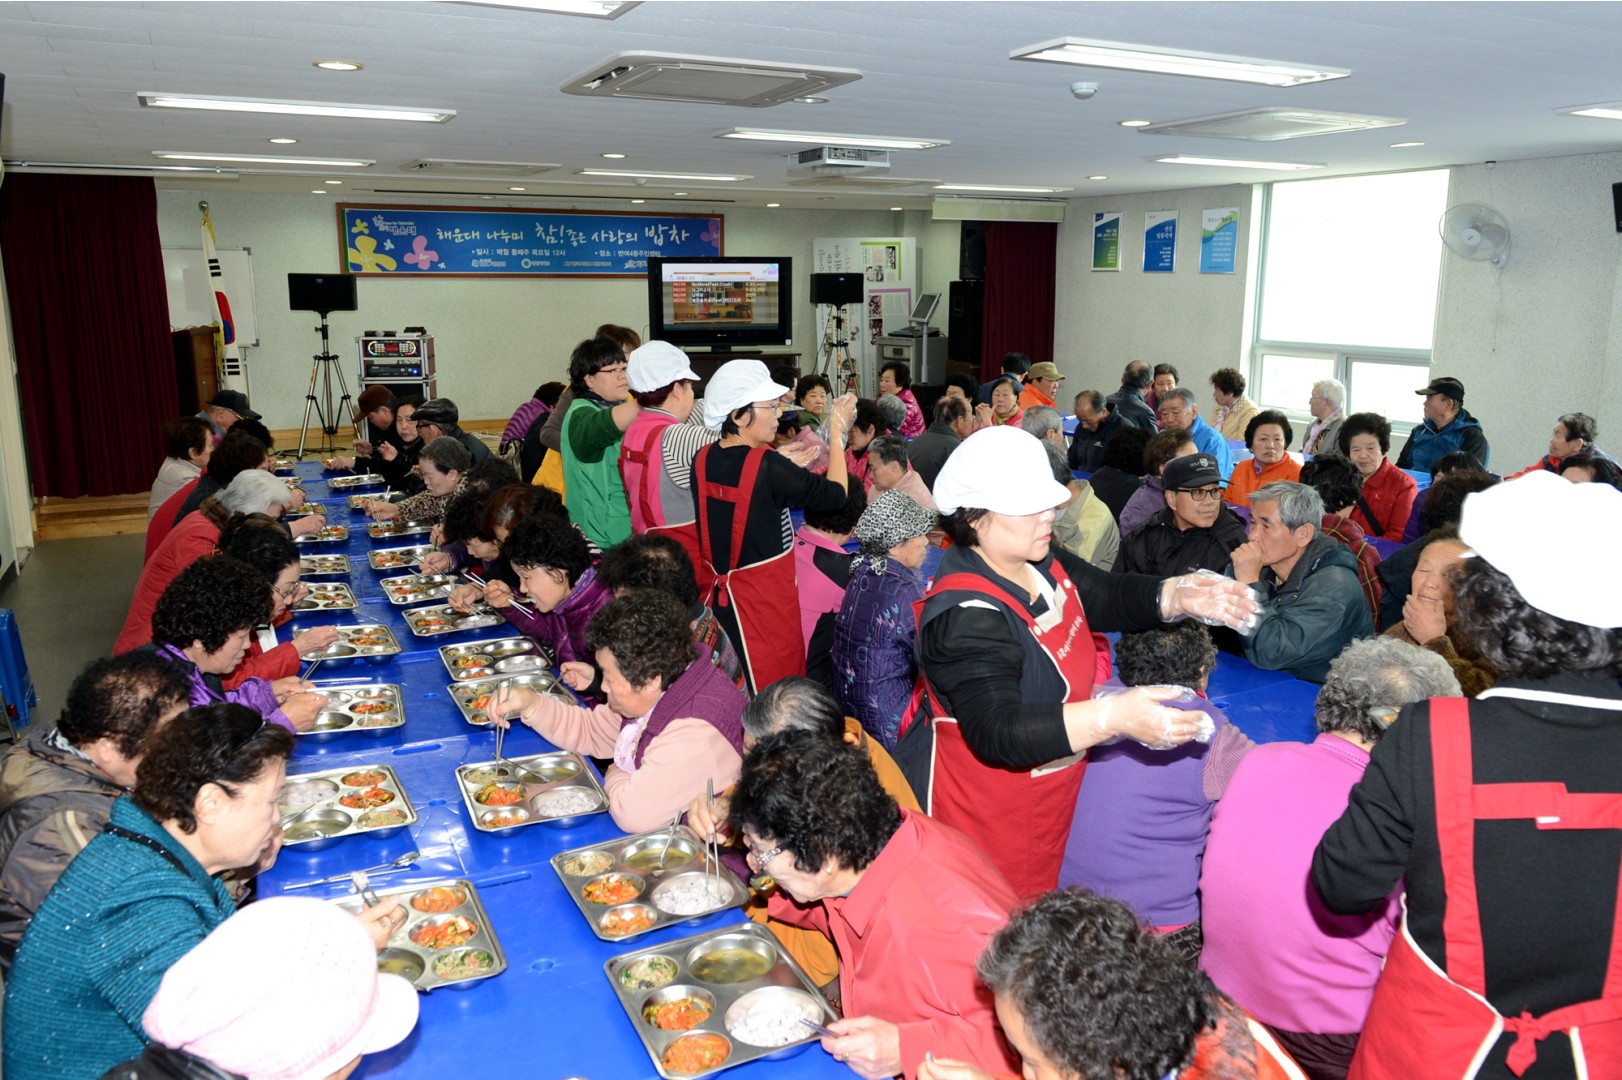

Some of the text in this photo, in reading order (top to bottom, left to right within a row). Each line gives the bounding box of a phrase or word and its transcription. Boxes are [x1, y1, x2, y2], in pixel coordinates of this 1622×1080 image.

[436, 228, 480, 243] 해운대
[486, 230, 524, 243] 나누미
[591, 229, 638, 245] 사랑의
[645, 223, 690, 246] 밥차
[552, 249, 566, 257] 12시
